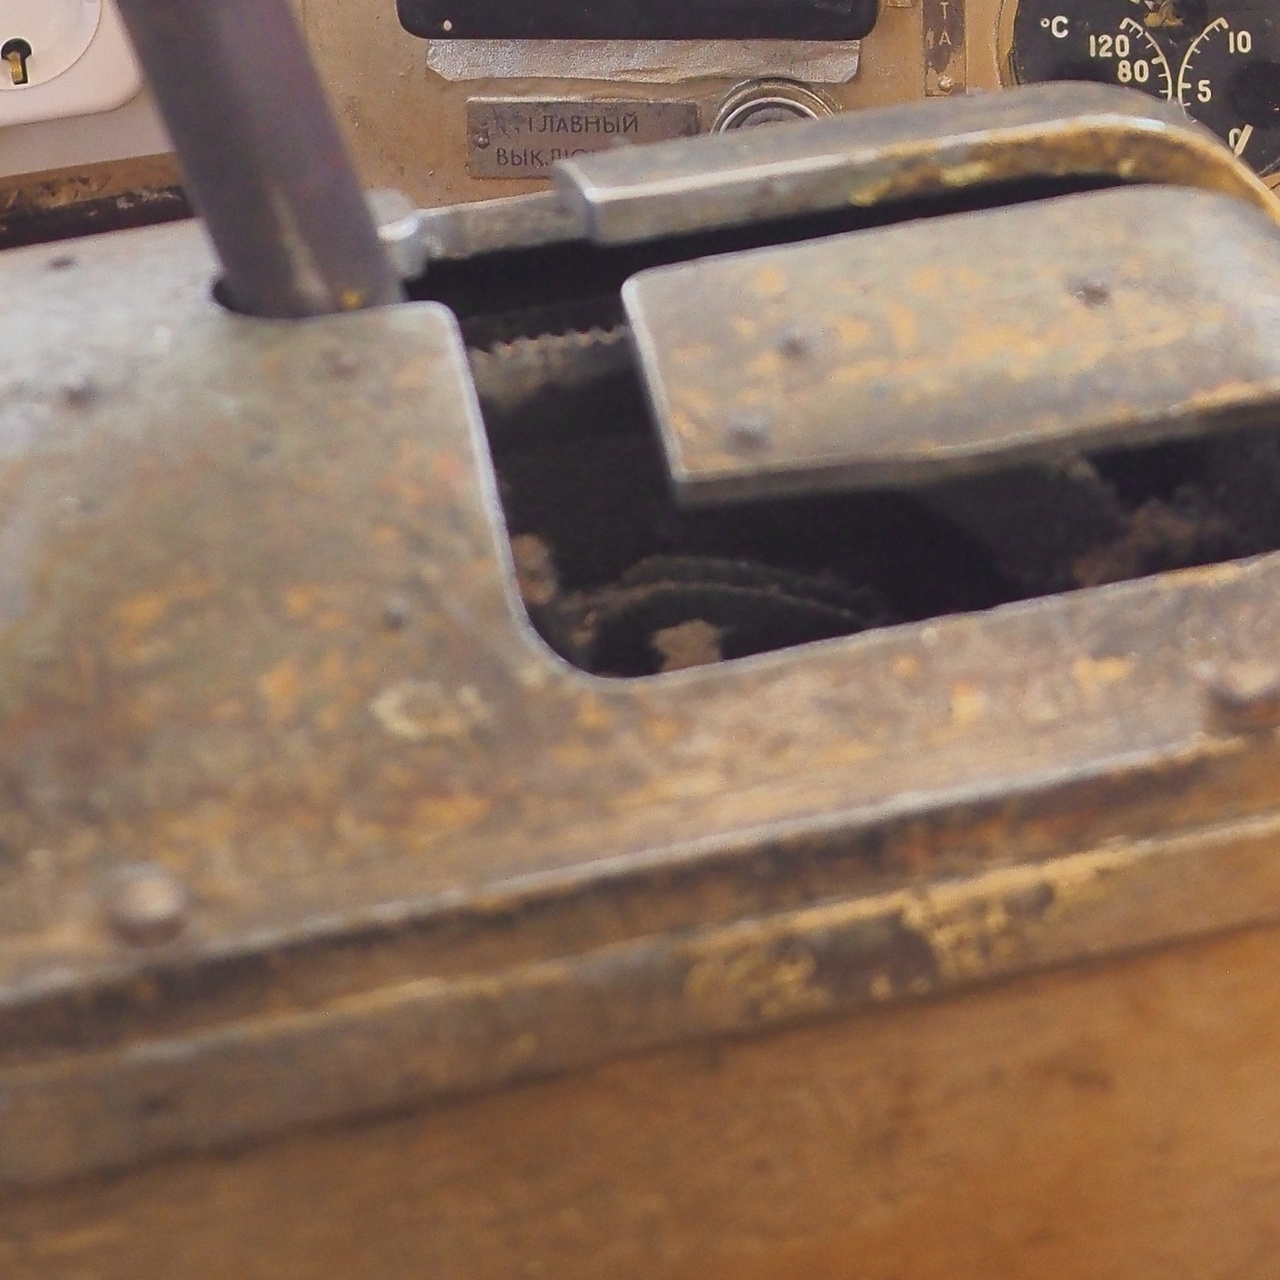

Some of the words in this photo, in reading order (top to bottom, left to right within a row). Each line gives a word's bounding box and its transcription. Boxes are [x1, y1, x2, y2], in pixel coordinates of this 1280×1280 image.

[1089, 34, 1130, 58] 120
[1229, 31, 1252, 54] 10
[1117, 60, 1149, 82] 80
[1197, 80, 1212, 102] 5
